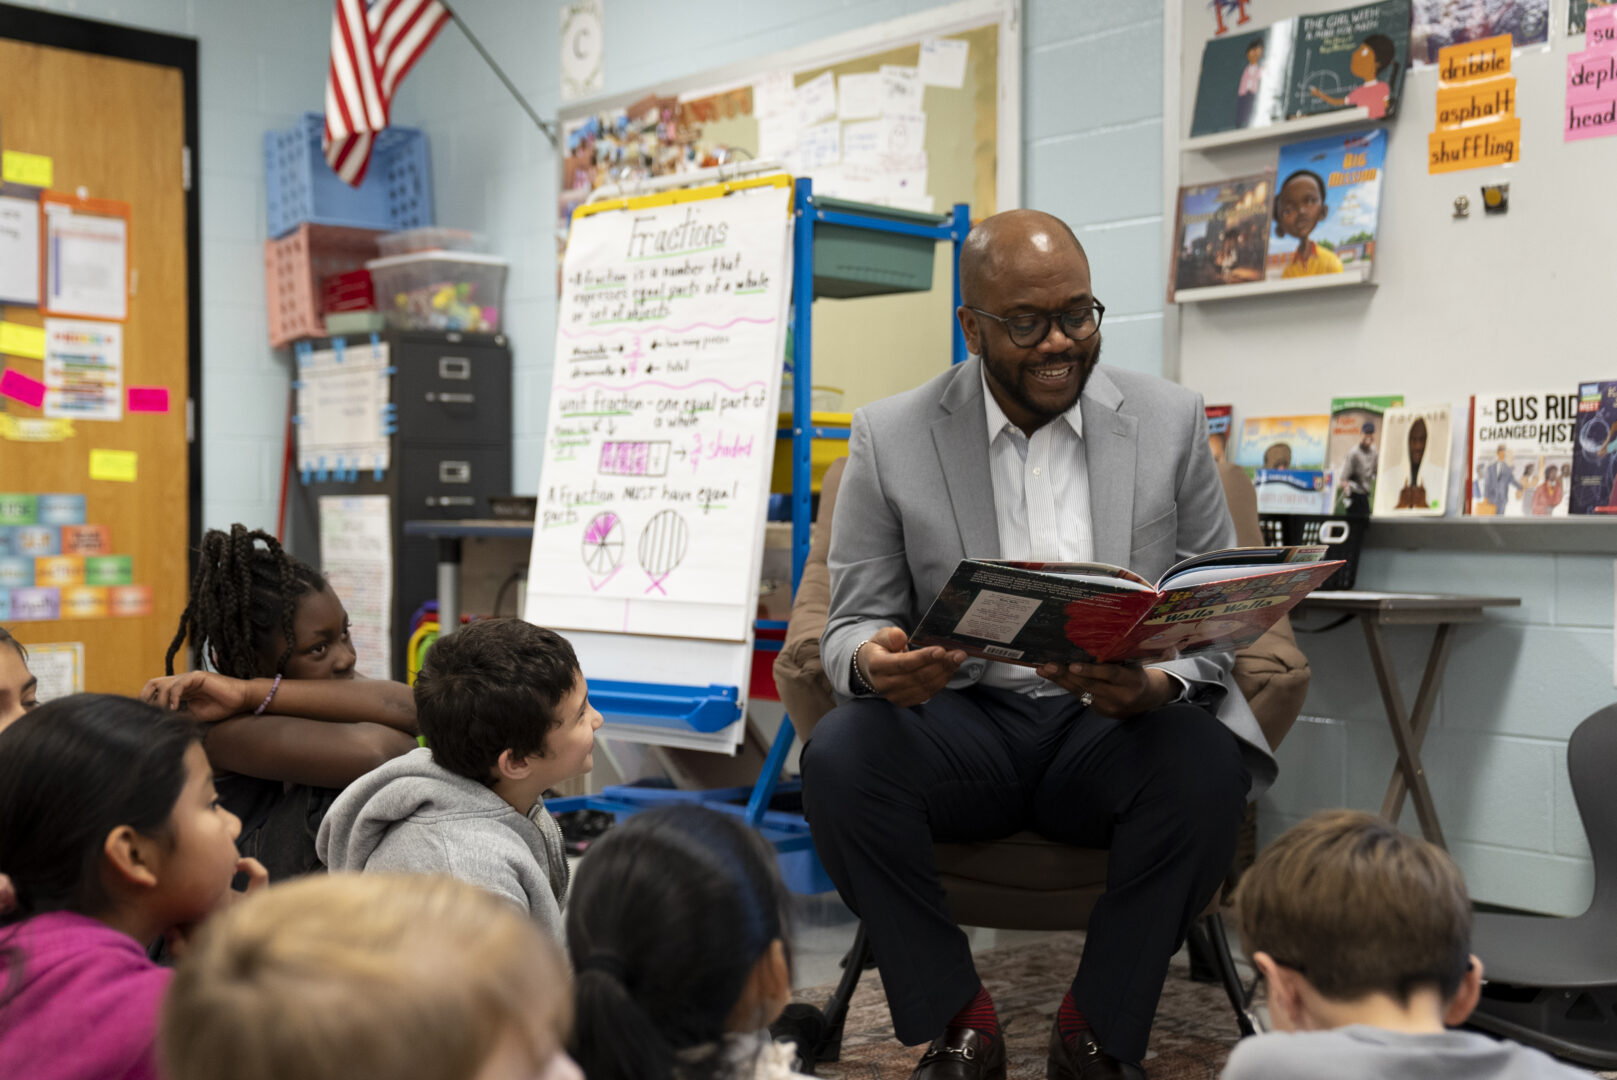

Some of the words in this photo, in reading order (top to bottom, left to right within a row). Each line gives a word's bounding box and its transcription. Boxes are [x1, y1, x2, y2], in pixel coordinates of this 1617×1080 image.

[573, 29, 590, 61] C
[1593, 27, 1617, 43] su
[1441, 48, 1506, 81] dribble
[1571, 57, 1617, 90] depl
[1439, 88, 1513, 127] asphalt
[1569, 99, 1616, 130] head
[1431, 133, 1514, 165] shuffling
[627, 206, 729, 257] Fractions
[663, 258, 704, 276] number
[712, 252, 742, 274] that
[705, 275, 721, 294] of
[735, 269, 770, 289] whole
[720, 391, 750, 417] part
[1495, 396, 1539, 424] BUS
[1479, 424, 1538, 442] CHANGED
[662, 483, 693, 502] have
[1164, 608, 1214, 623] Walla
[1223, 599, 1273, 614] Walla
